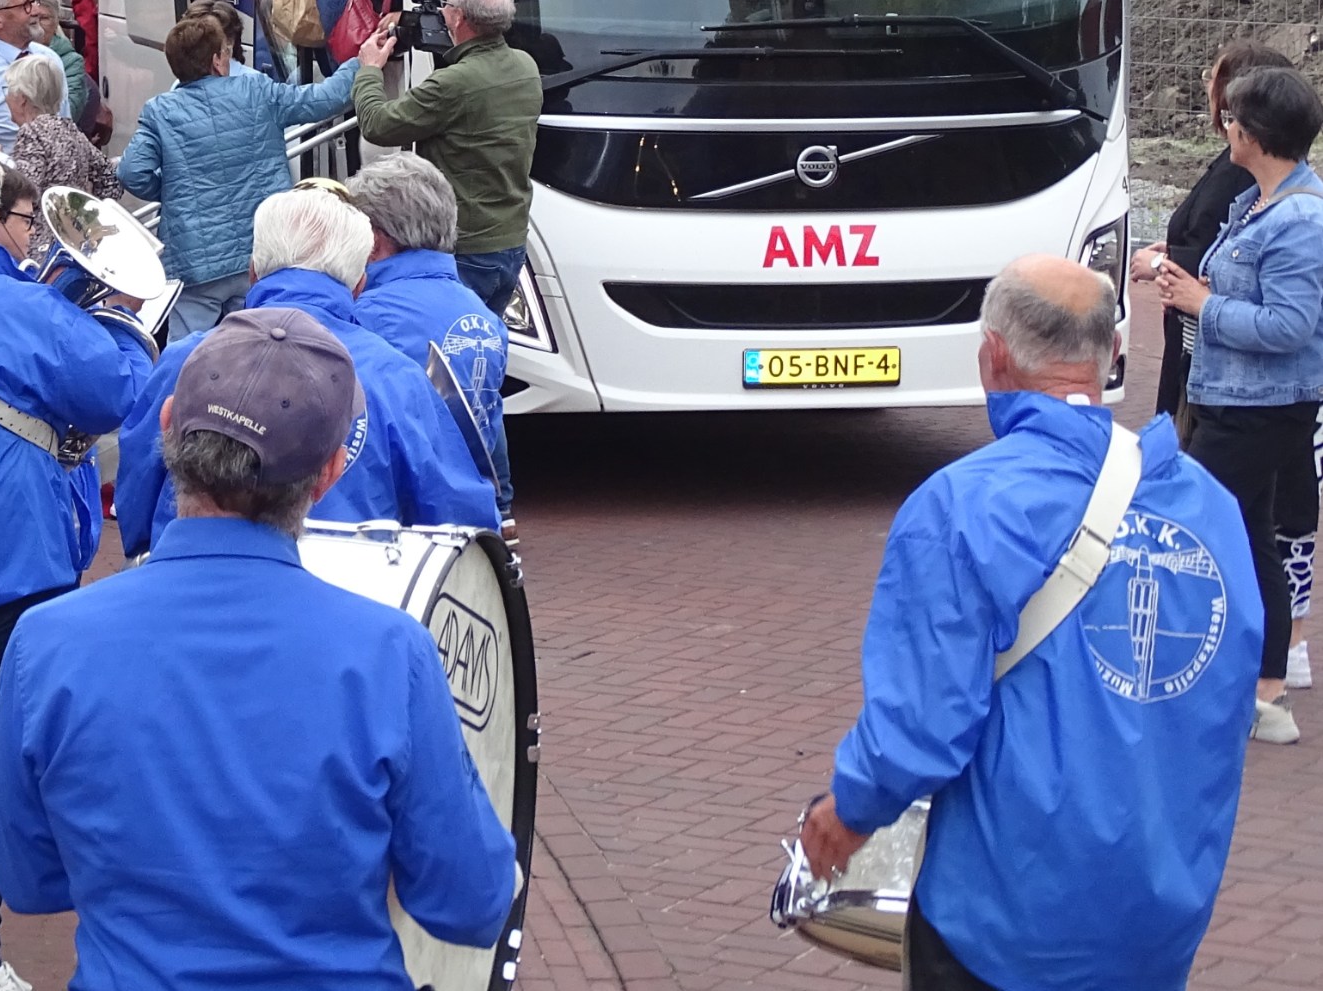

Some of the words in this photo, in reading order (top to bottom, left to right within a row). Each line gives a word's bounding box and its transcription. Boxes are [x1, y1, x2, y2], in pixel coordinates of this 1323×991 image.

[762, 224, 880, 268] AMZ
[768, 353, 891, 378] 05-BNF-4
[207, 403, 267, 436] WESTKAPELLE
[437, 608, 491, 714] ADAMS
[1163, 596, 1225, 694] Westkapelle
